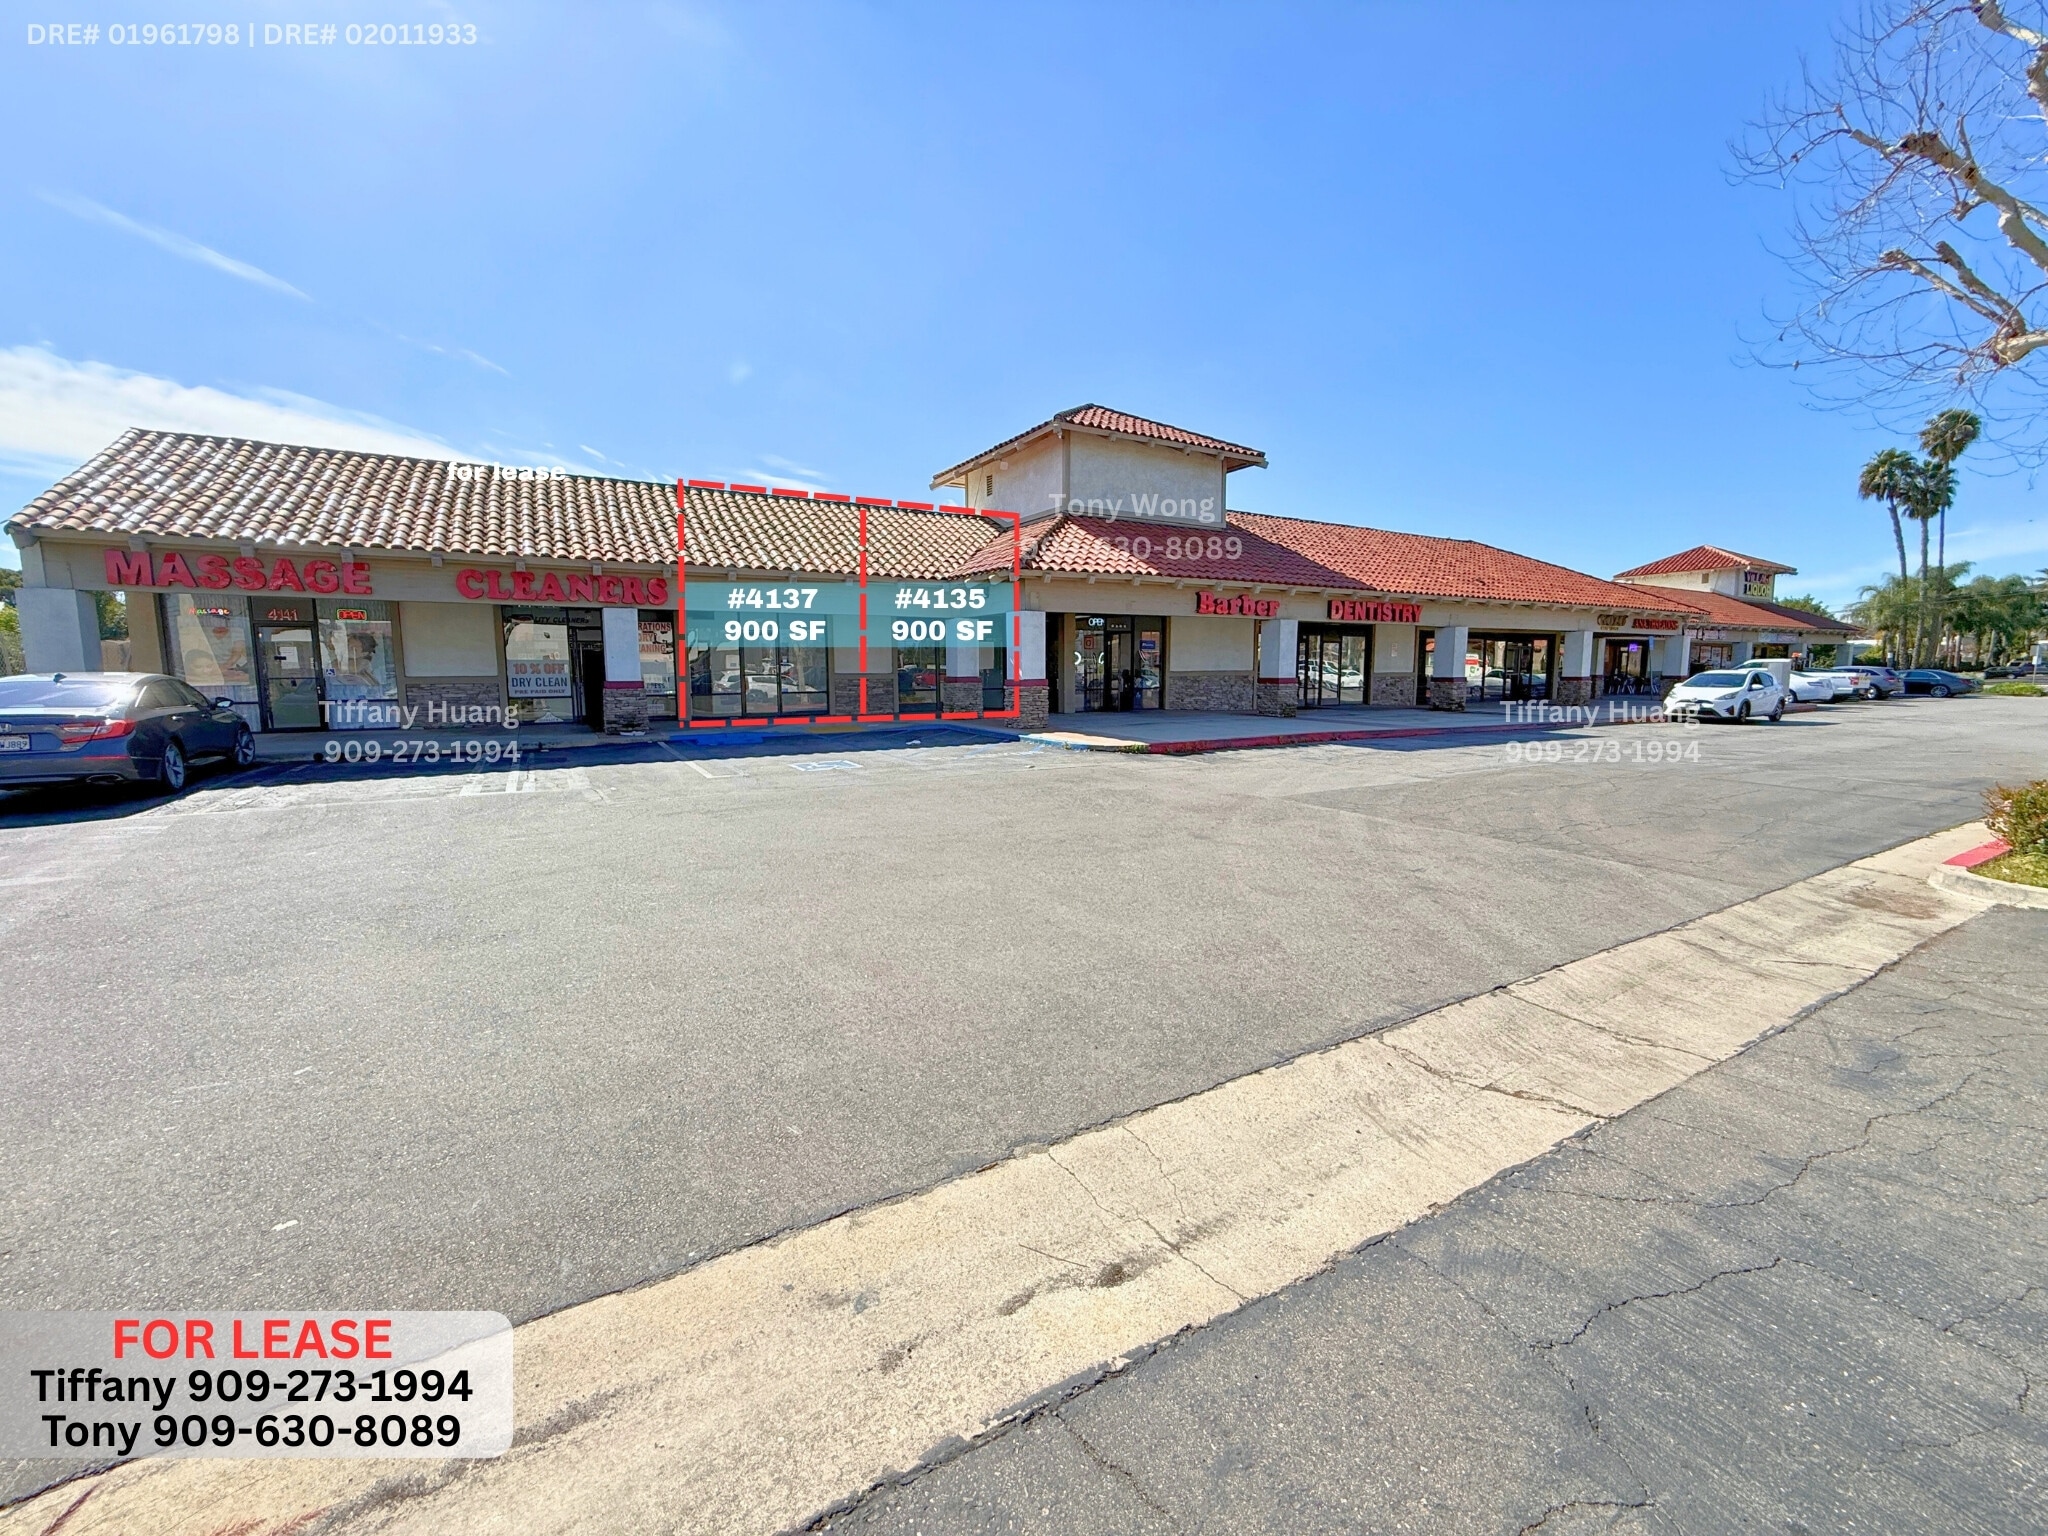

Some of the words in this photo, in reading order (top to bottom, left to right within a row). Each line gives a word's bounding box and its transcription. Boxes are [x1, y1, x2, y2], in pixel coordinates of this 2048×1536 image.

[103, 549, 373, 595] MASSAGE
[456, 569, 668, 605] CLEANERS
[338, 610, 366, 620] OPEN
[1197, 591, 1280, 617] Barber
[1329, 600, 1423, 623] DENTISTRY
[513, 663, 528, 674] 10
[543, 663, 565, 674] OFF
[511, 677, 532, 688] DRY
[535, 677, 568, 687] CLEAN
